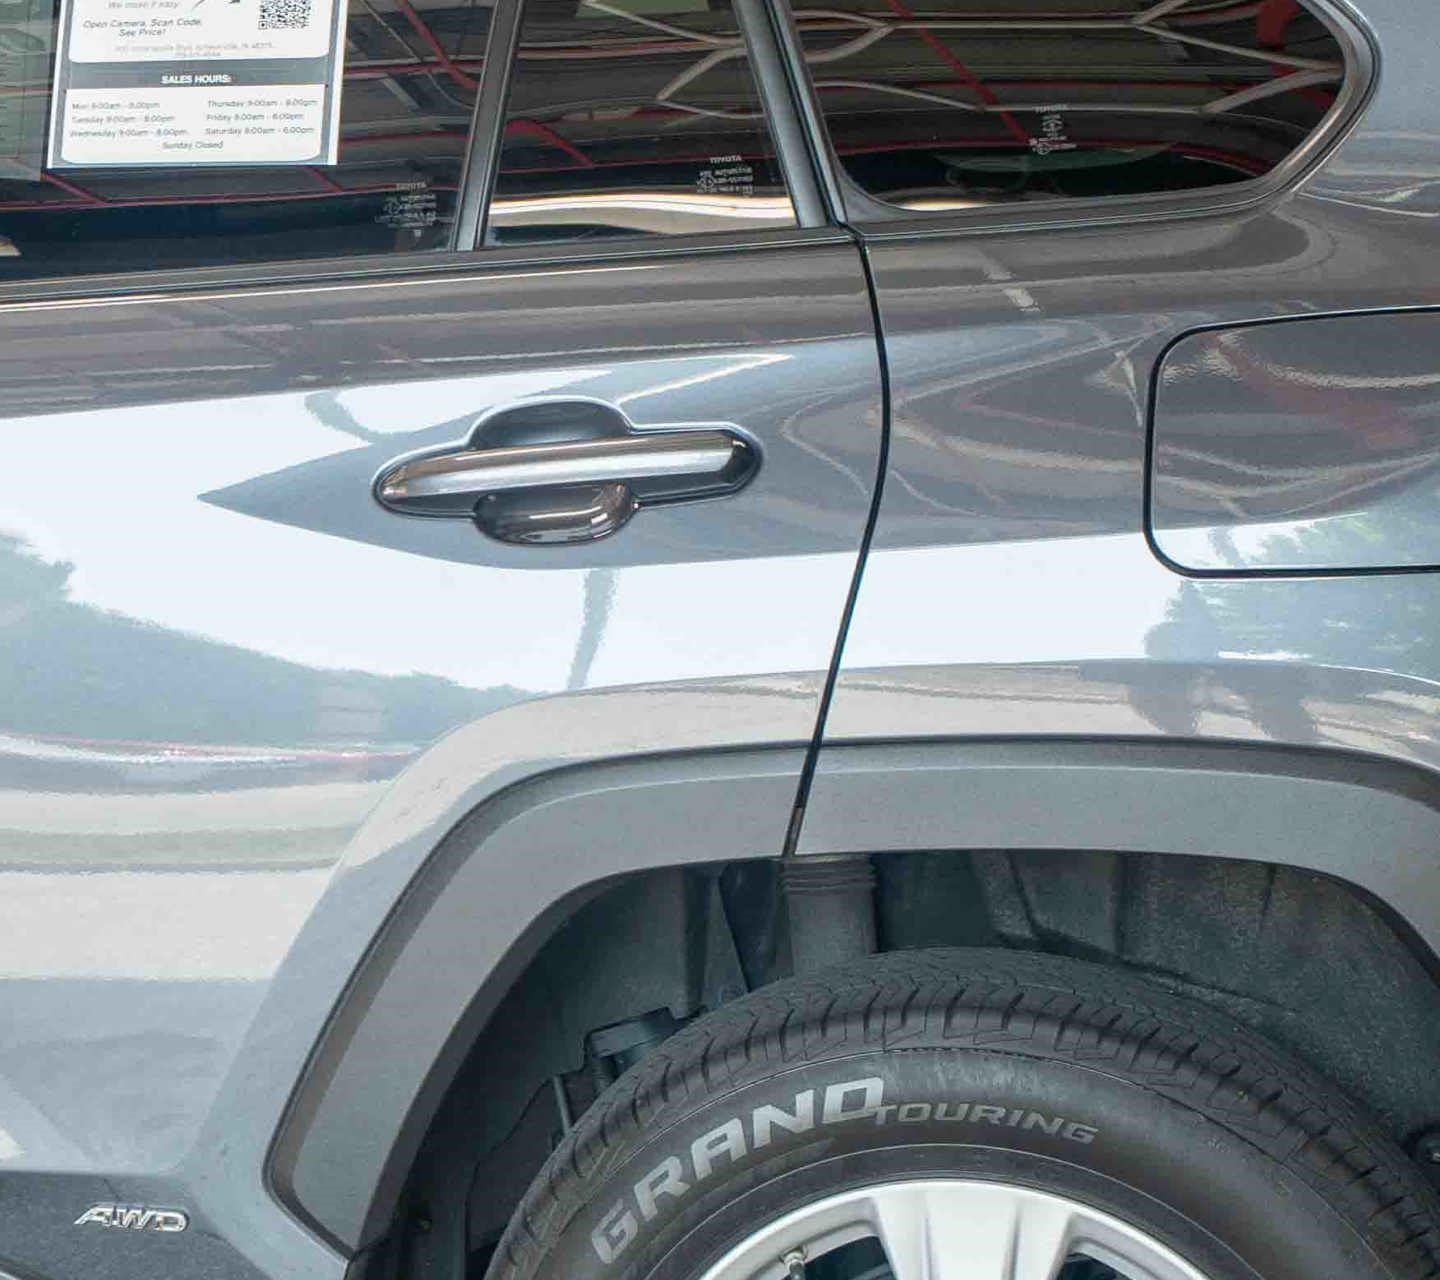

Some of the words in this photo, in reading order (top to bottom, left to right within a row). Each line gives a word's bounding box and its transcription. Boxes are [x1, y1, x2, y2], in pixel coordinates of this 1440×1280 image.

[160, 75, 192, 84] SALES
[194, 74, 232, 83] HOURS:
[591, 1076, 886, 1264] GRAND
[871, 1102, 1101, 1145] TOURING
[73, 1204, 187, 1233] AWD
